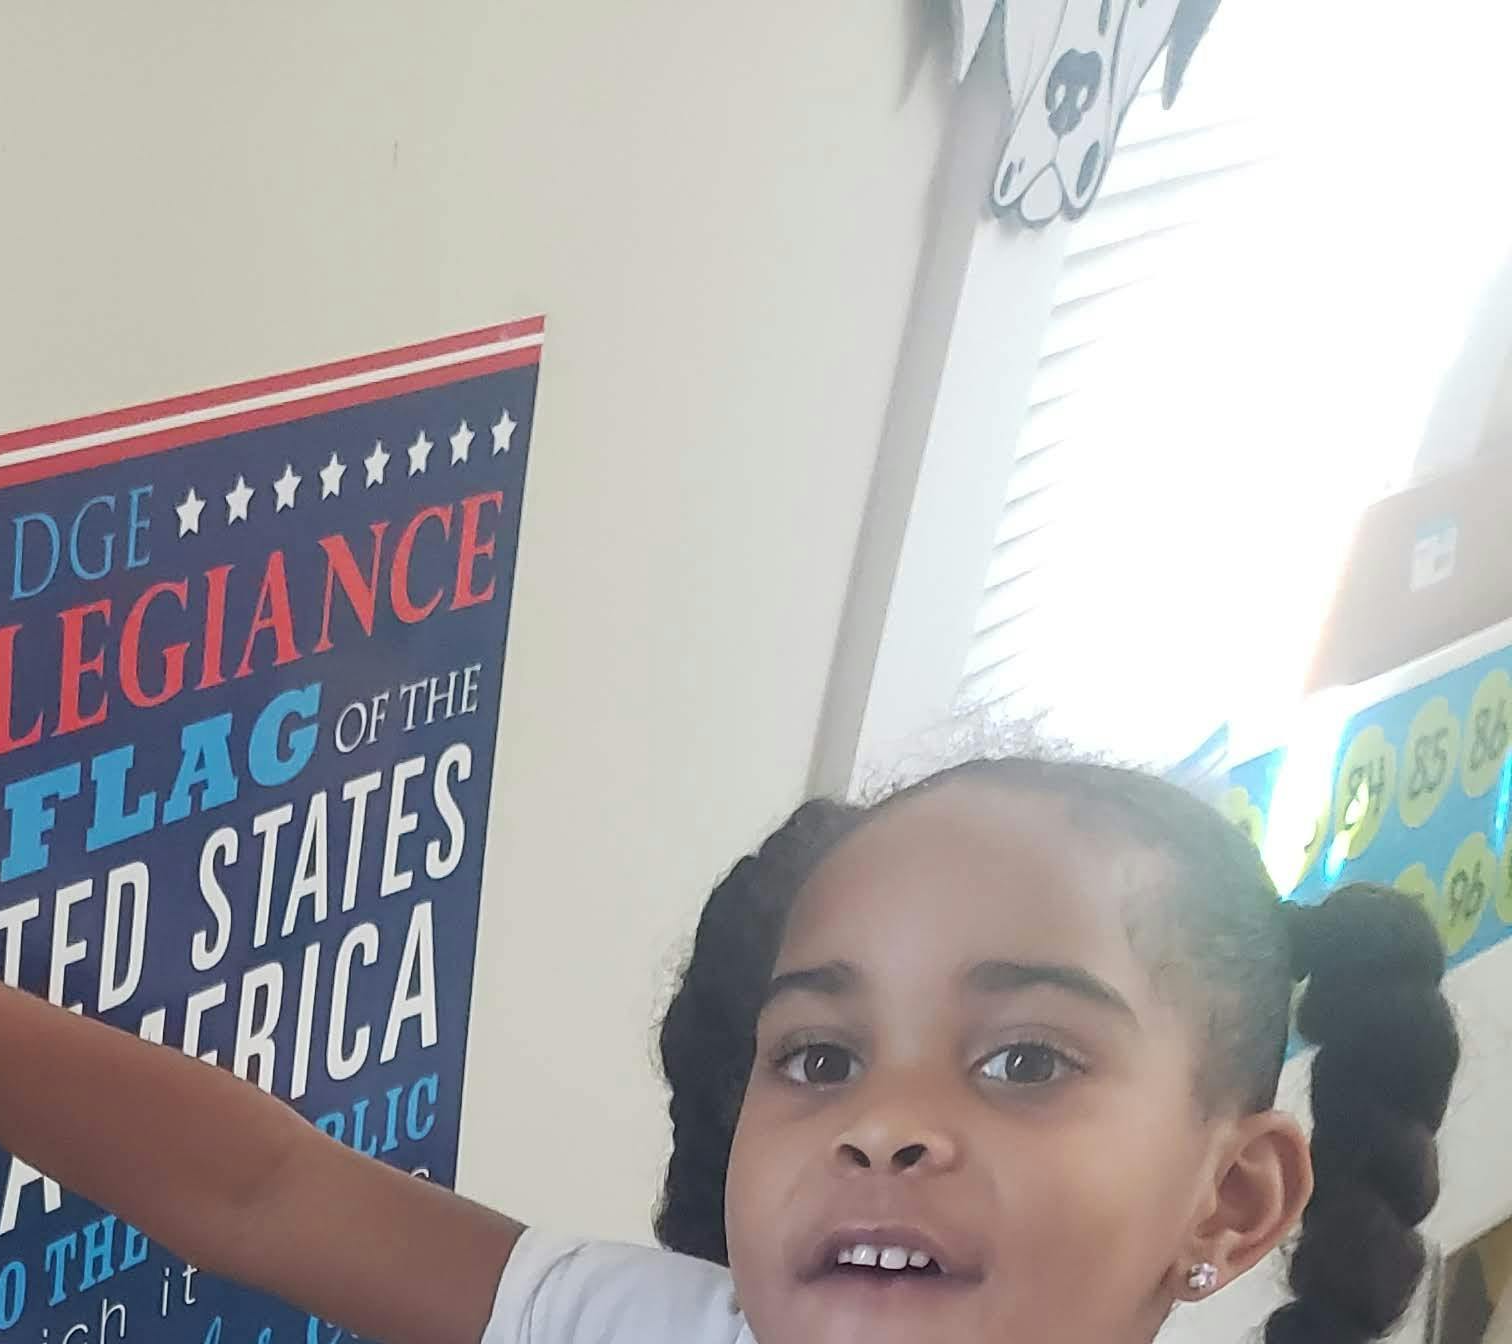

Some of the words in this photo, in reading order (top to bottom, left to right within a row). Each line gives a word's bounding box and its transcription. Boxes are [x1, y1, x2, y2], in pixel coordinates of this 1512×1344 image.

[0, 682, 322, 881] FLAG
[333, 689, 389, 754] OF
[400, 664, 481, 728] THE
[1407, 727, 1448, 800] 85
[1469, 698, 1508, 772] 86
[191, 743, 472, 971] STATES
[162, 1264, 198, 1317] it
